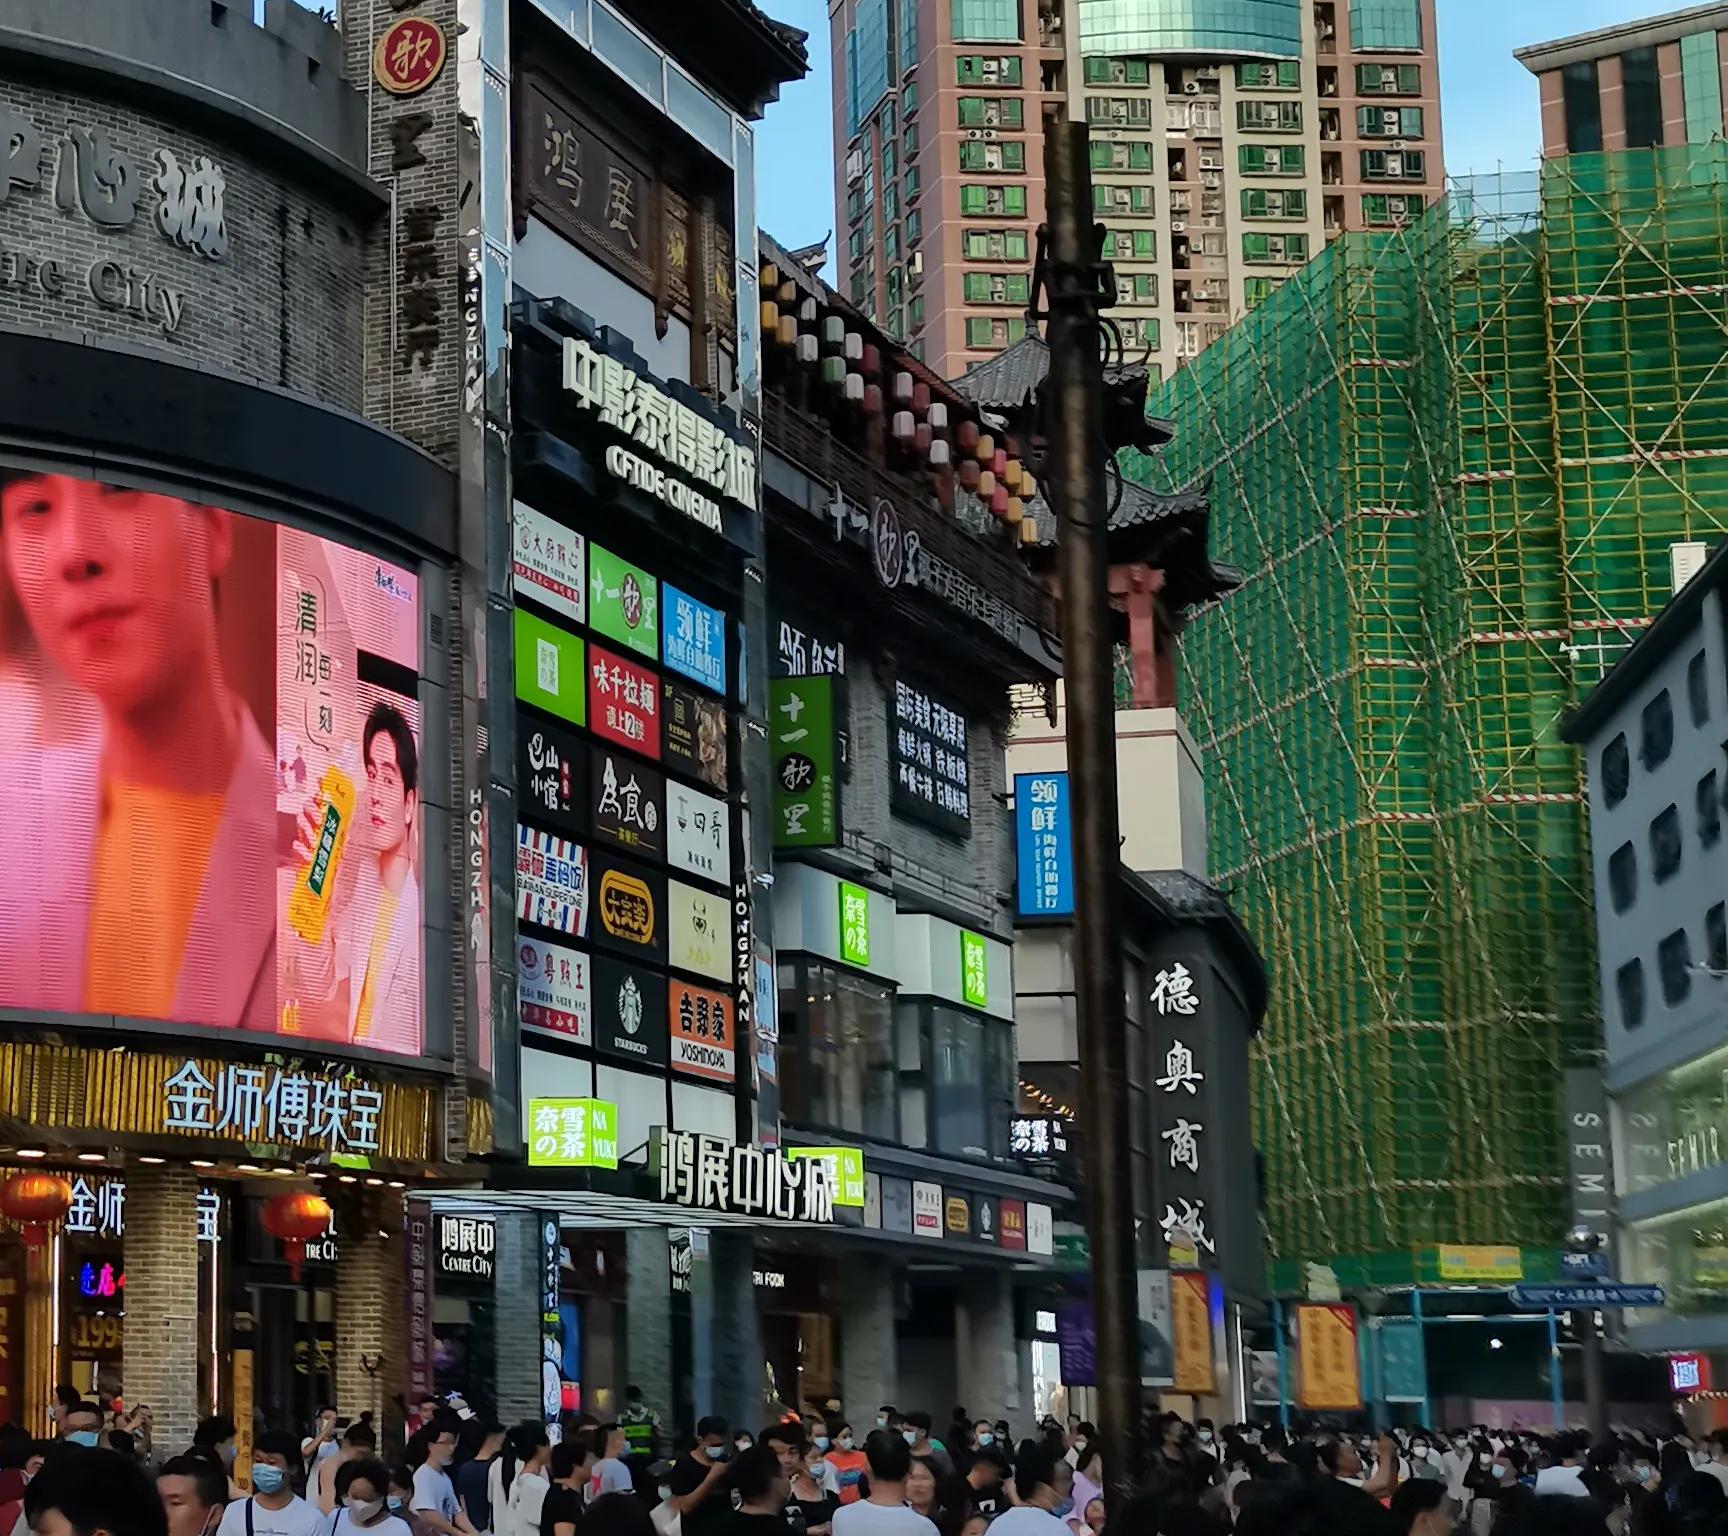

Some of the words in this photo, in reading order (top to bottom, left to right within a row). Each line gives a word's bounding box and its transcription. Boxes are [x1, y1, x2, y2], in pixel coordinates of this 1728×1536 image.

[87, 261, 189, 336] City
[668, 476, 724, 535] CINEMA
[294, 590, 319, 687] 清润
[318, 651, 333, 735] 每一刻
[735, 883, 751, 1023] HONGZHAN
[163, 1058, 384, 1151] 金师傅珠宝
[534, 1105, 586, 1133] 奈雪
[534, 1132, 587, 1160] の茶
[659, 1130, 835, 1223] 鸿展中心城
